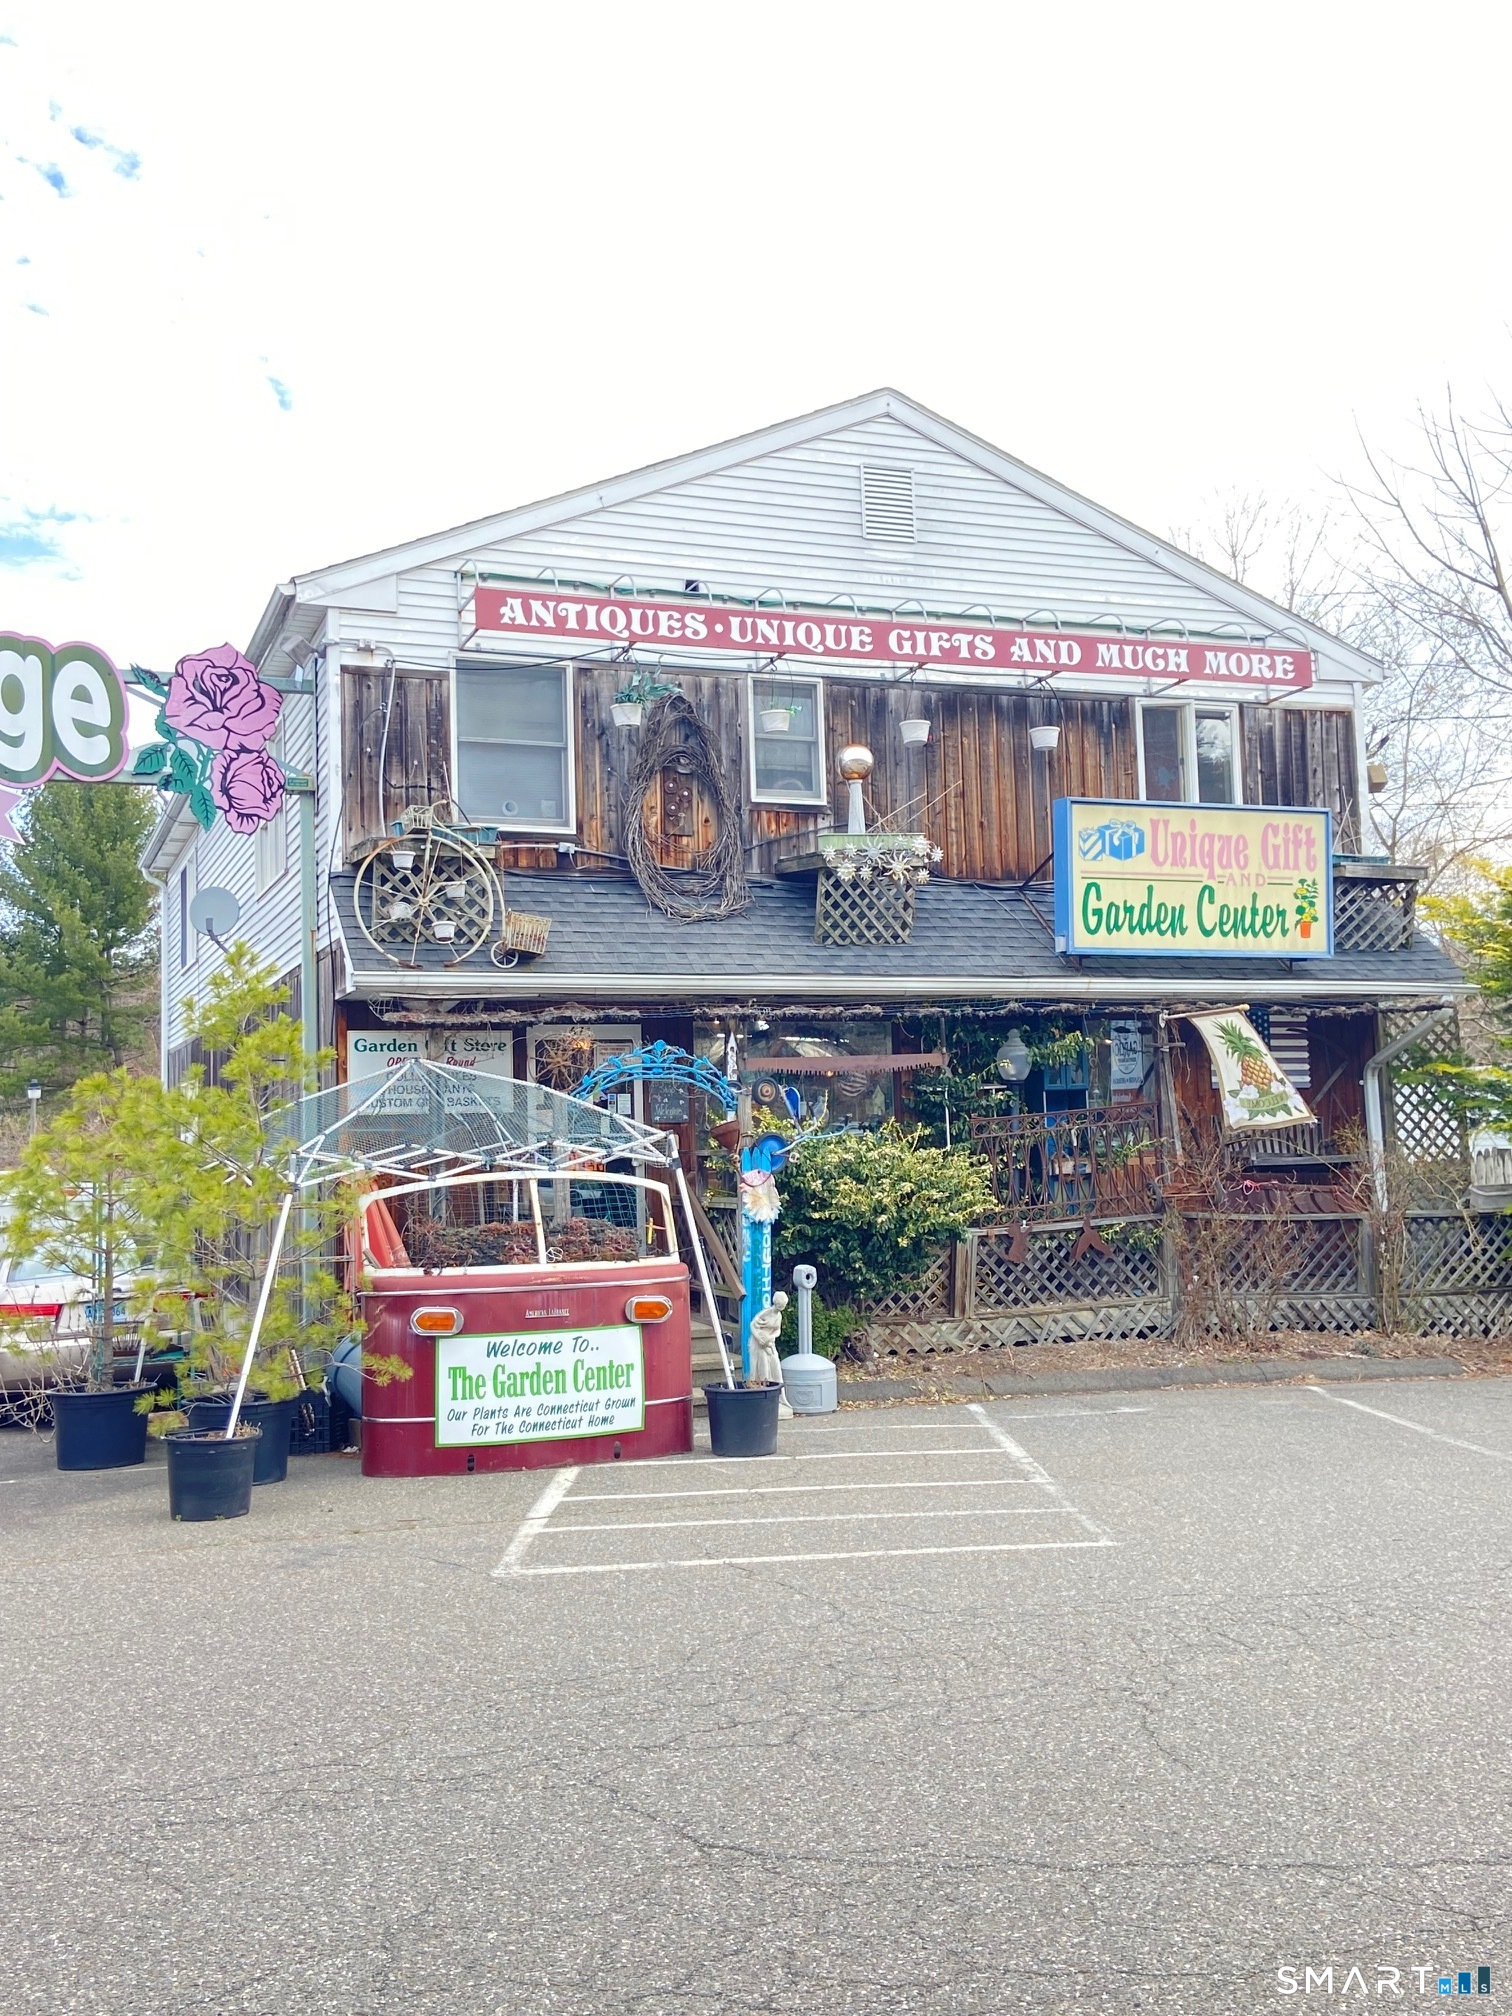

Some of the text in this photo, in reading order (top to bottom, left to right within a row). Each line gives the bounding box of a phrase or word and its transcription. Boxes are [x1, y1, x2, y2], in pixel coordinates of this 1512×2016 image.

[499, 596, 1296, 681] ANTIQUES UNIQUE GIFTS AND MUCH MORE
[1150, 818, 1318, 880] Unique Gift
[1226, 874, 1267, 887] AND
[1082, 882, 1290, 940] Garden Center
[354, 1039, 418, 1053] Garden
[463, 1038, 507, 1052] Store
[446, 1057, 477, 1067] Round
[486, 1336, 600, 1359] Welcome To..
[447, 1358, 635, 1401] The Garden Center
[447, 1397, 636, 1422] Our Plants Are Connecticut Grown
[471, 1415, 615, 1436] For The Connecticut Home
